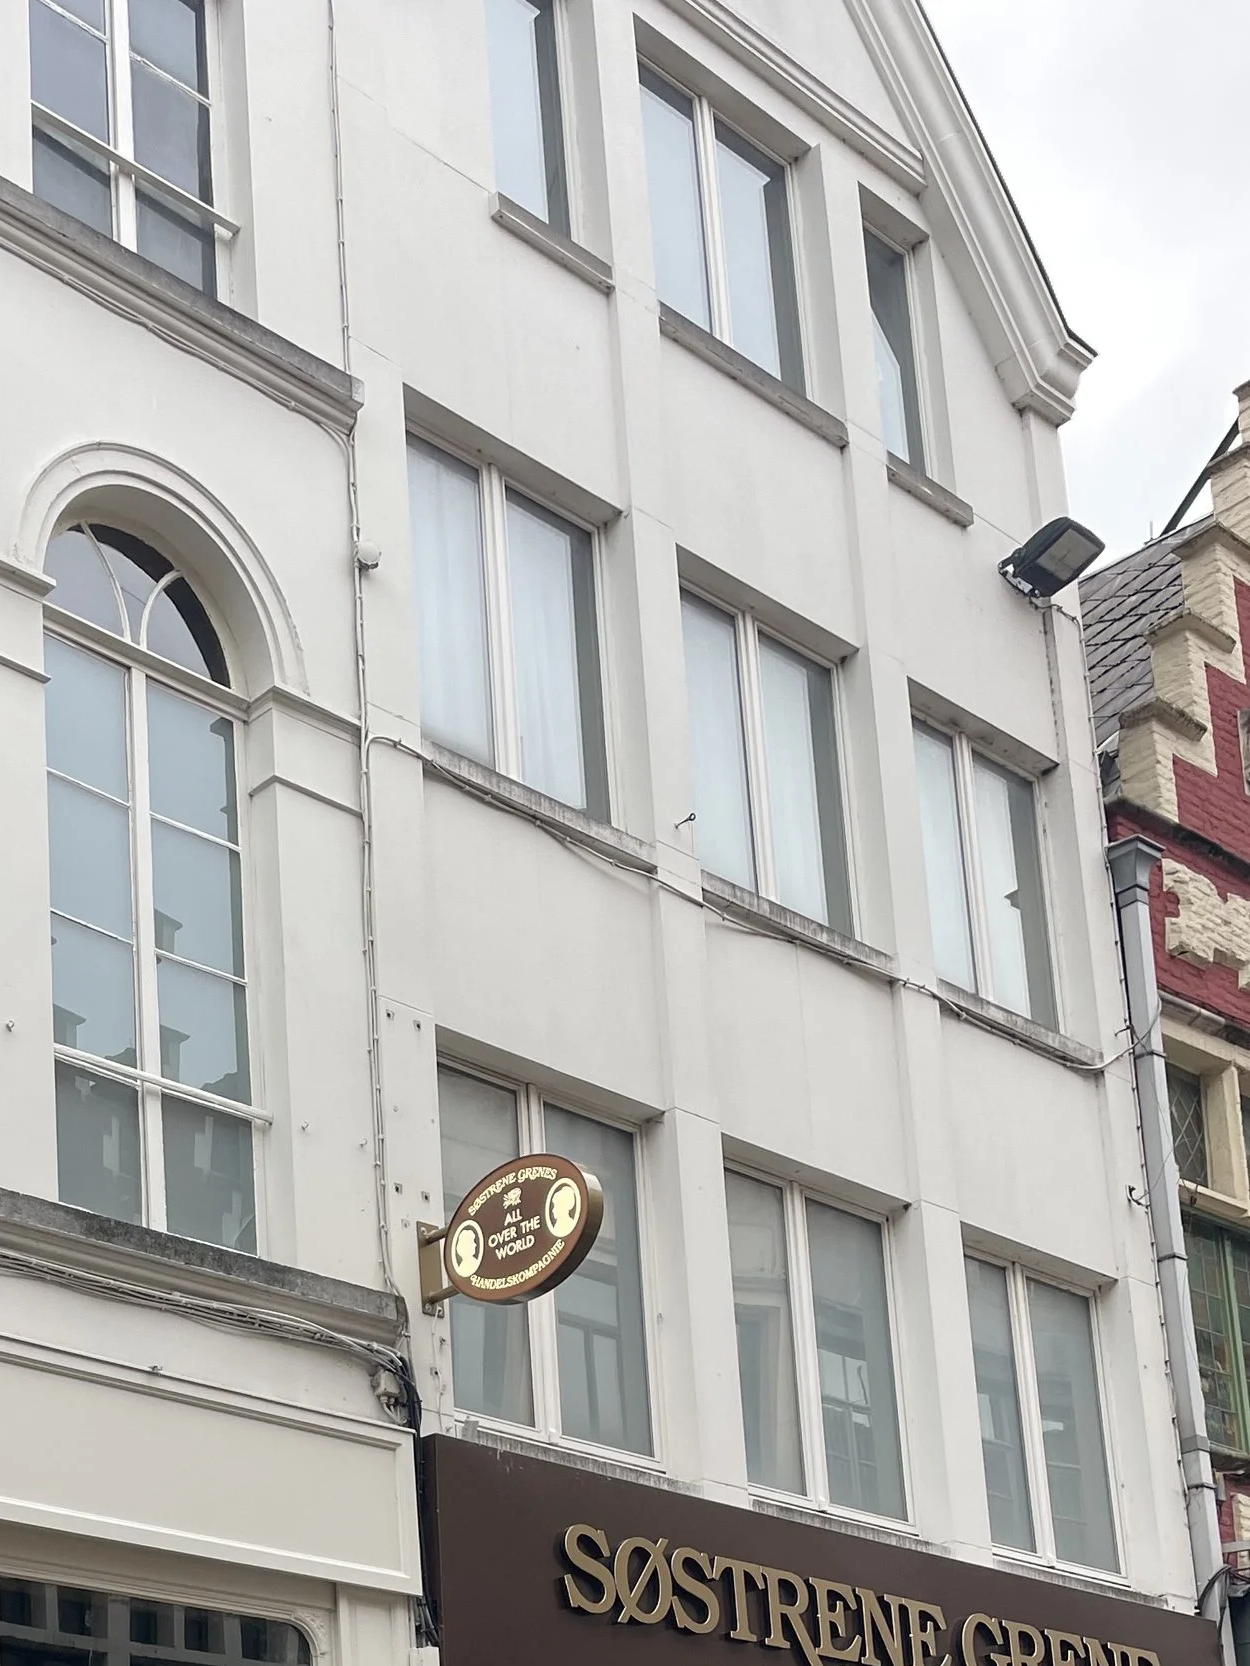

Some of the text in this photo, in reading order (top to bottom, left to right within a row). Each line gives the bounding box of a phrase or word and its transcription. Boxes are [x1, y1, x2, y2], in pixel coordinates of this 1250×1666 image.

[467, 1166, 558, 1216] SØSTRENE GRENES
[488, 1215, 541, 1248] OVER THE
[504, 1209, 523, 1226] ALL
[495, 1235, 535, 1260] WORLD
[471, 1239, 566, 1290] HANDELSKOMPAGNIE
